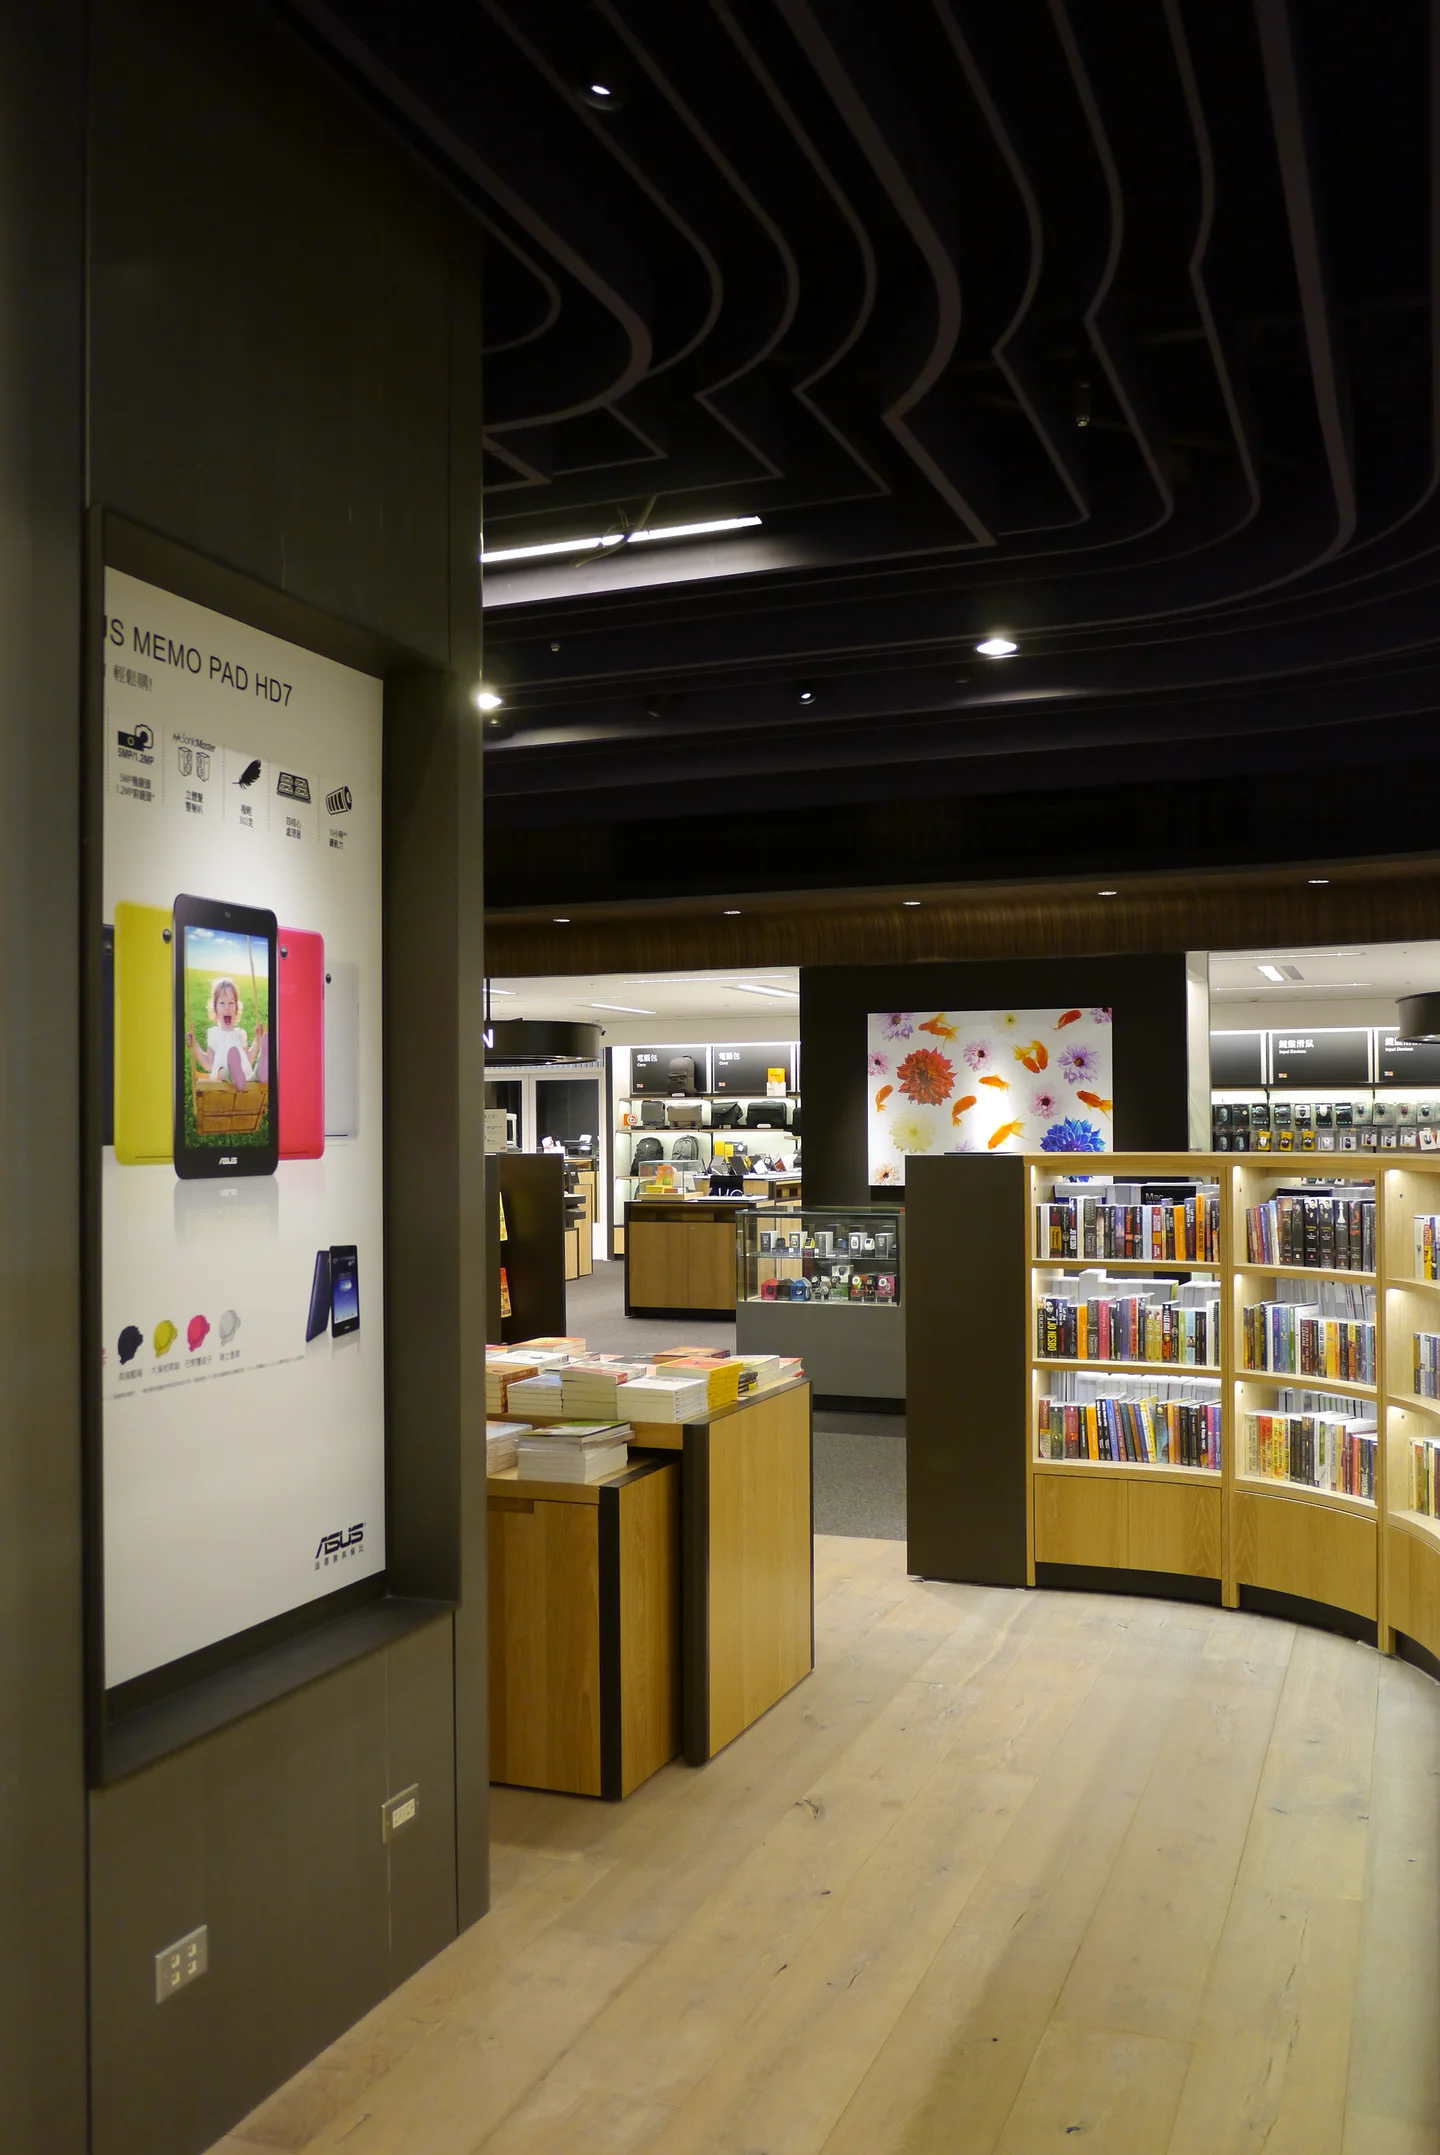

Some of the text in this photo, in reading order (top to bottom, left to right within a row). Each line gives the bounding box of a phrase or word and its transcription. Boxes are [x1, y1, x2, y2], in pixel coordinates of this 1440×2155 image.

[133, 626, 201, 674] MEMO
[209, 655, 248, 691] PAD
[255, 672, 293, 706] HD7
[117, 747, 155, 766] 5MP/1.2MP
[1278, 1039, 1314, 1048] 鍵盤滑鼠
[637, 1054, 658, 1063] 電腦包
[719, 1052, 741, 1061] 電腦包
[218, 1157, 238, 1165] ASUS
[1145, 1192, 1164, 1201] Mac
[1047, 1321, 1057, 1351] JO NESBO
[315, 1522, 363, 1559] ASUS
